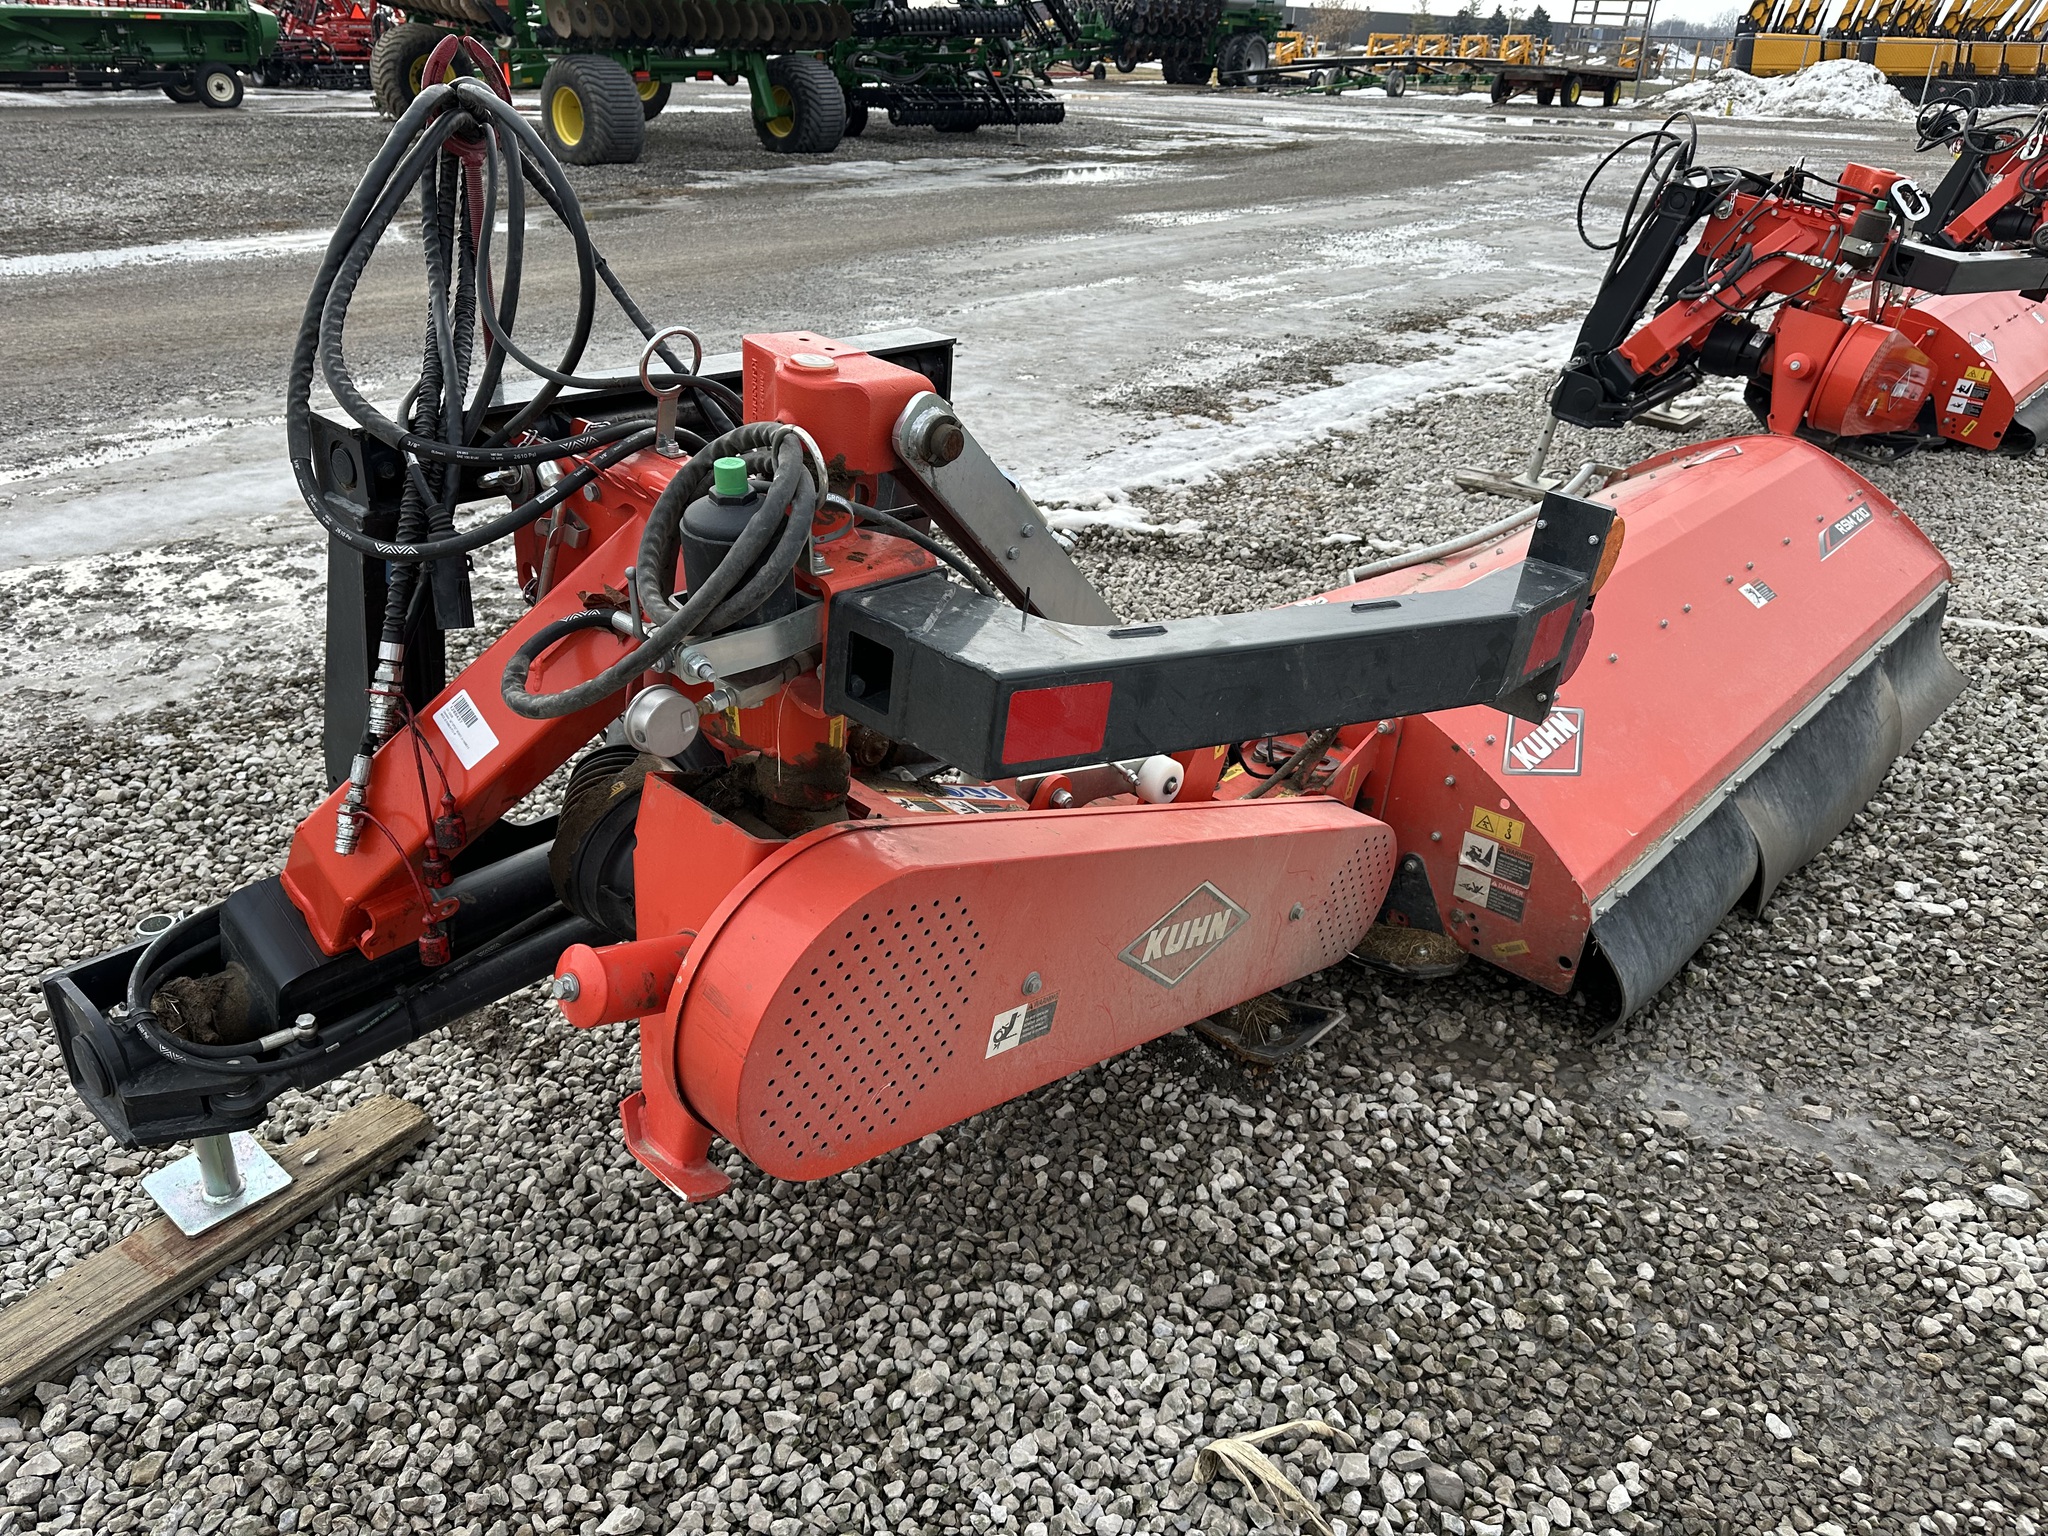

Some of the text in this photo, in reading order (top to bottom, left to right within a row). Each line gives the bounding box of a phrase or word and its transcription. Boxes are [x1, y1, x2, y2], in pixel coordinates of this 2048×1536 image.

[1834, 507, 1871, 535] RSM 210
[1509, 711, 1579, 771] KUHN
[1506, 847, 1533, 862] WARNING
[1498, 882, 1524, 897] DANGER
[1141, 908, 1232, 964] KUHN
